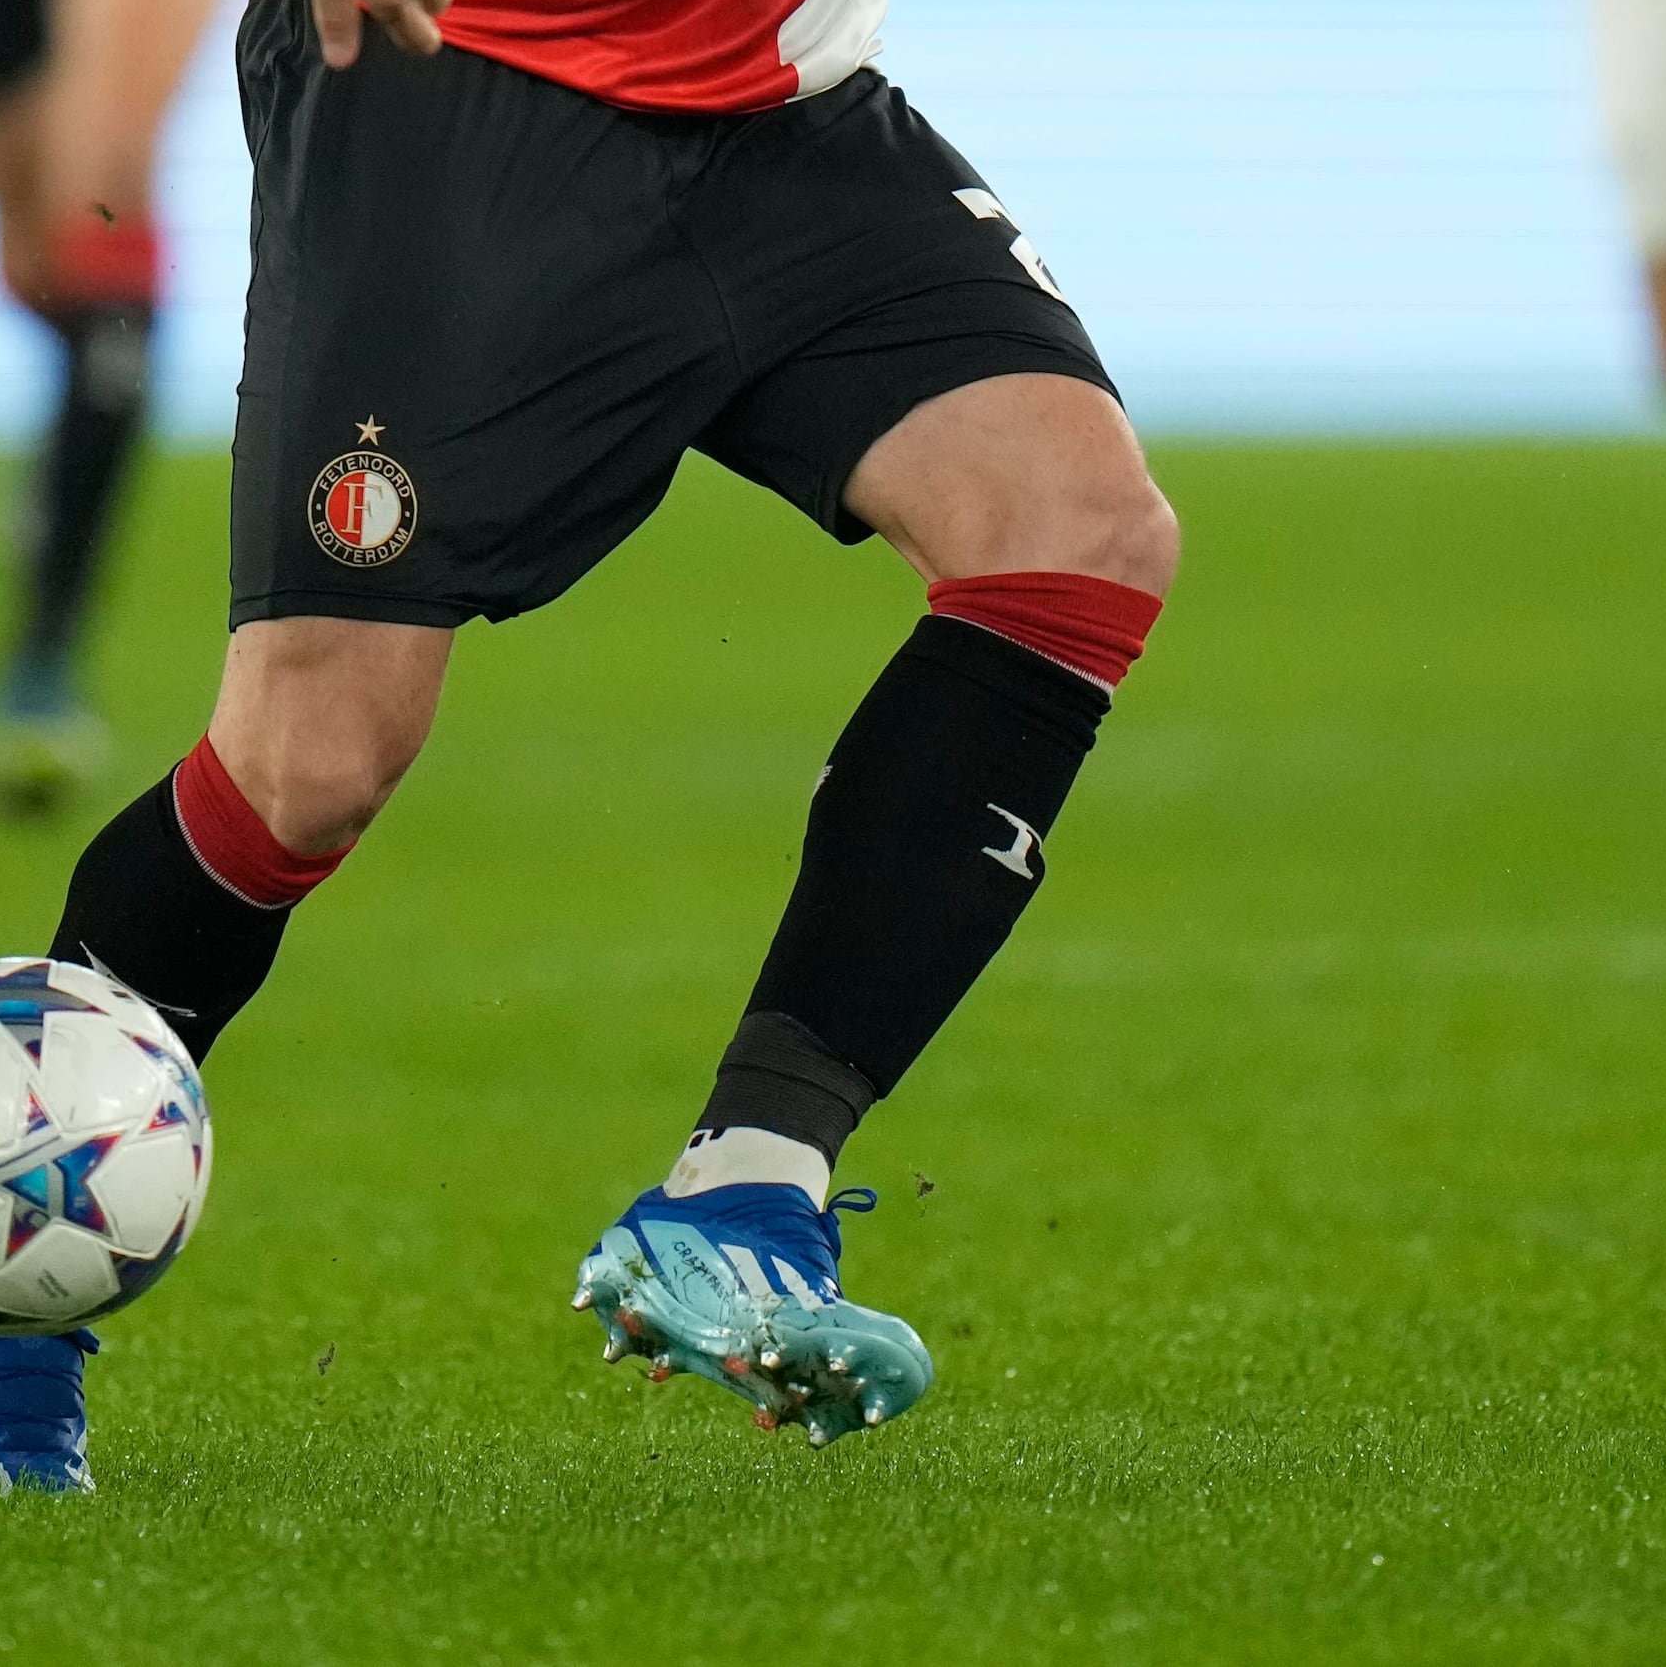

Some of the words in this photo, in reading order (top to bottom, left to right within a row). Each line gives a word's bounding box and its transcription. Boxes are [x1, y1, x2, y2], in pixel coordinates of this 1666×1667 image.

[318, 455, 410, 498] FEYENOORD
[340, 482, 383, 535] F
[314, 520, 409, 564] ROTTERDAM
